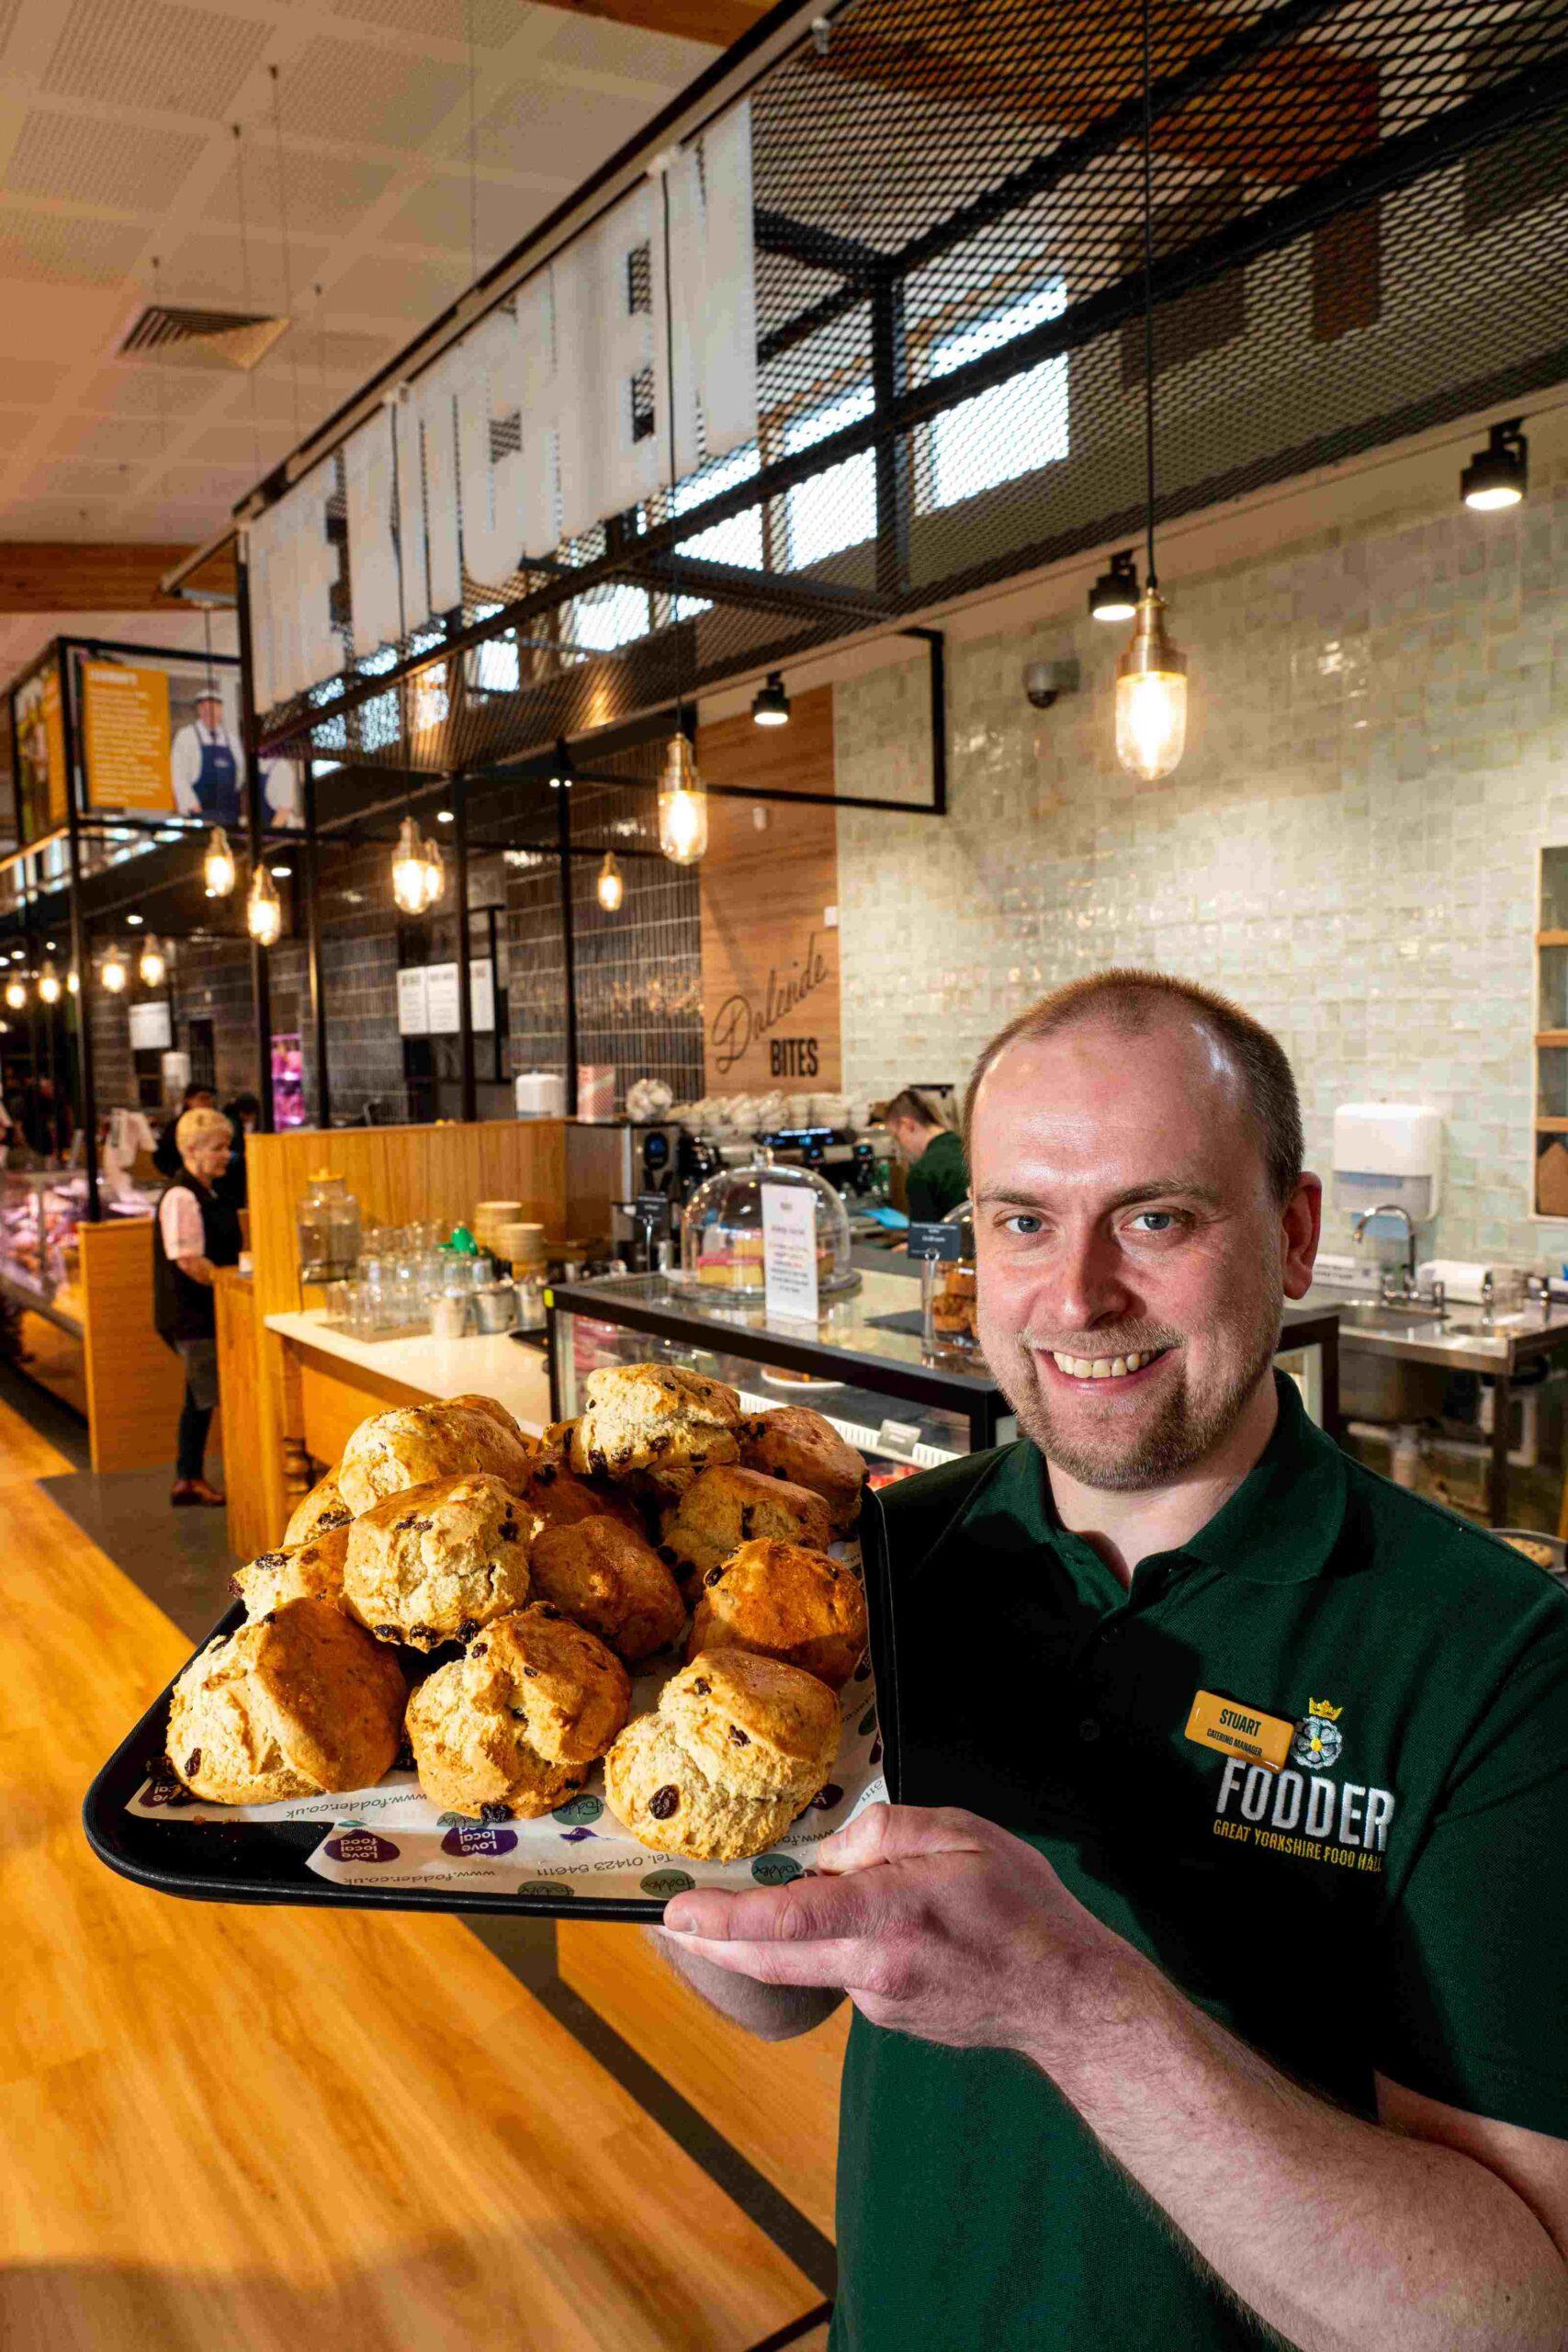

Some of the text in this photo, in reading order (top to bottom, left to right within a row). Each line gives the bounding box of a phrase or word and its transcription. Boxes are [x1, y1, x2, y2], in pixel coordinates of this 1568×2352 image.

[770, 1036, 818, 1078] BITES
[1219, 1709, 1261, 1736] STUART
[1207, 1728, 1234, 1747] CATERING
[285, 1792, 427, 1819] www.fodder.co.uk
[1215, 1757, 1395, 1852] FODDER
[341, 1838, 378, 1847] food
[459, 1831, 496, 1844] local
[461, 1841, 497, 1853] Love
[1213, 1819, 1251, 1843] GREAT
[1255, 1826, 1321, 1860] YORKSHIRE
[1323, 1846, 1356, 1869] FOOD
[341, 1844, 378, 1852] local
[341, 1851, 378, 1860] Love
[536, 1852, 674, 1876] Tel. 01423 546111
[343, 1870, 496, 1886] www.fodder.co.uk
